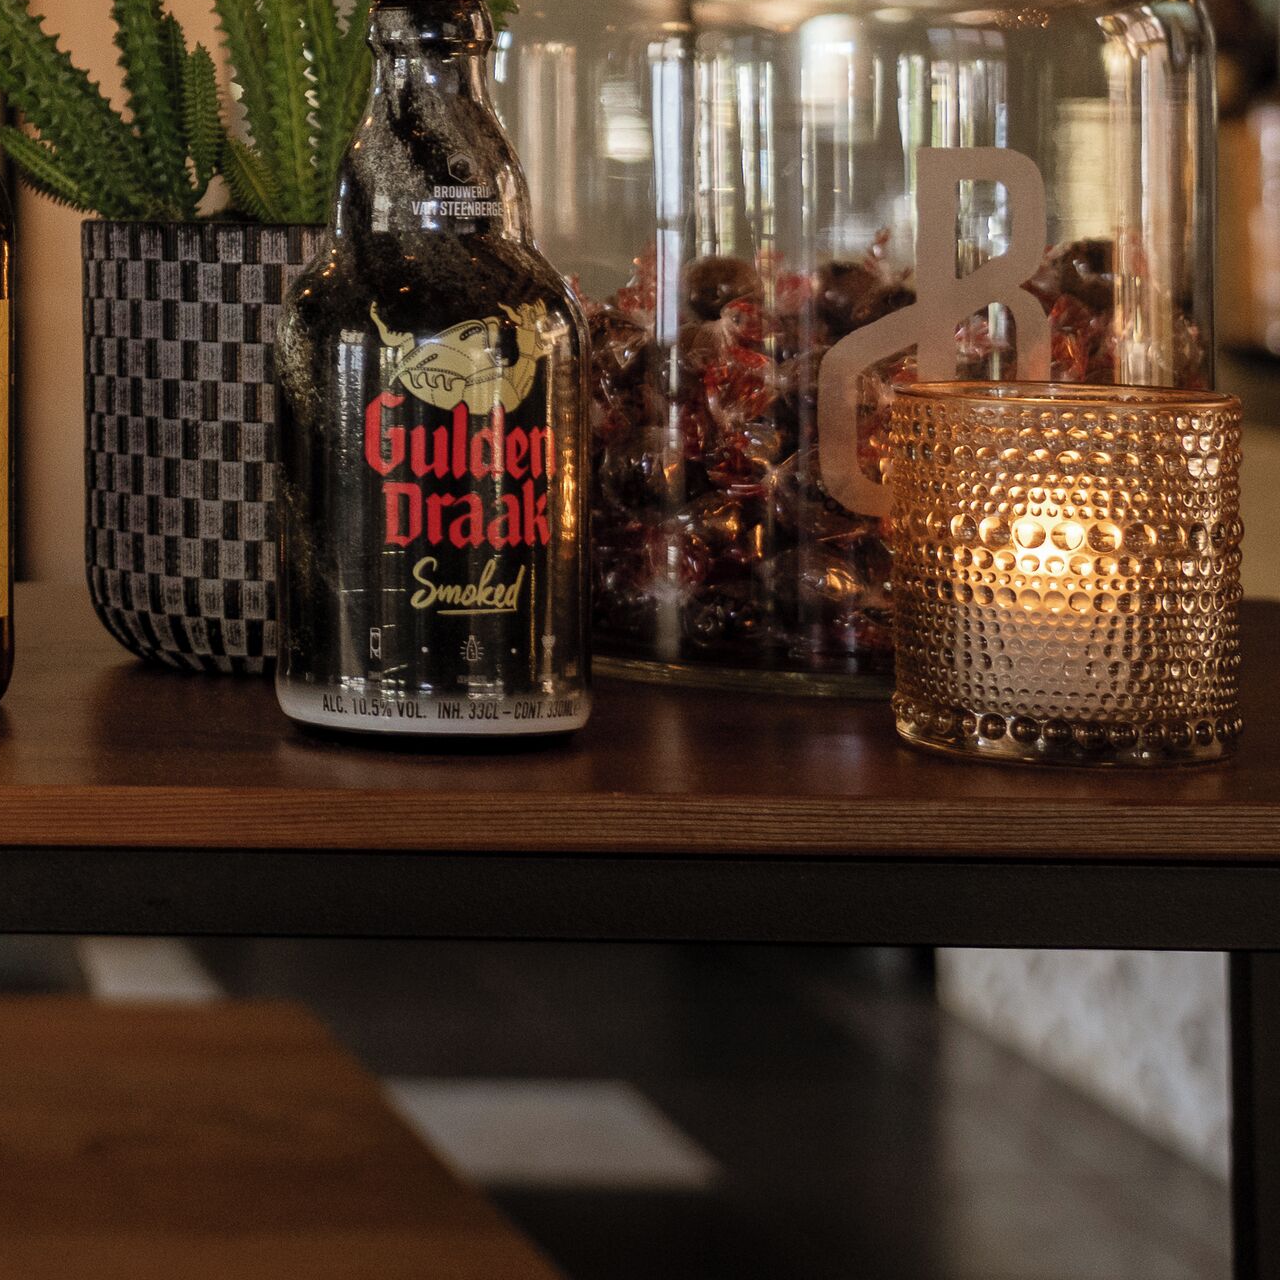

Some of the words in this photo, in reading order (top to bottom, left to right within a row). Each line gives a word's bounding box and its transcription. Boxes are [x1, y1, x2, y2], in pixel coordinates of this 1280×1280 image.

[412, 201, 437, 216] VAN
[440, 201, 504, 217] STEENBERGE
[434, 185, 489, 198] BROUWERIJ
[364, 391, 557, 481] Gulden
[382, 478, 552, 552] Draak
[410, 556, 526, 610] Smoked
[323, 694, 348, 714] ALC.
[352, 698, 392, 718] 10.5%
[396, 701, 427, 719] VOL.
[438, 701, 464, 719] INH.
[468, 702, 499, 720] 33CL
[514, 701, 544, 720] CONT.
